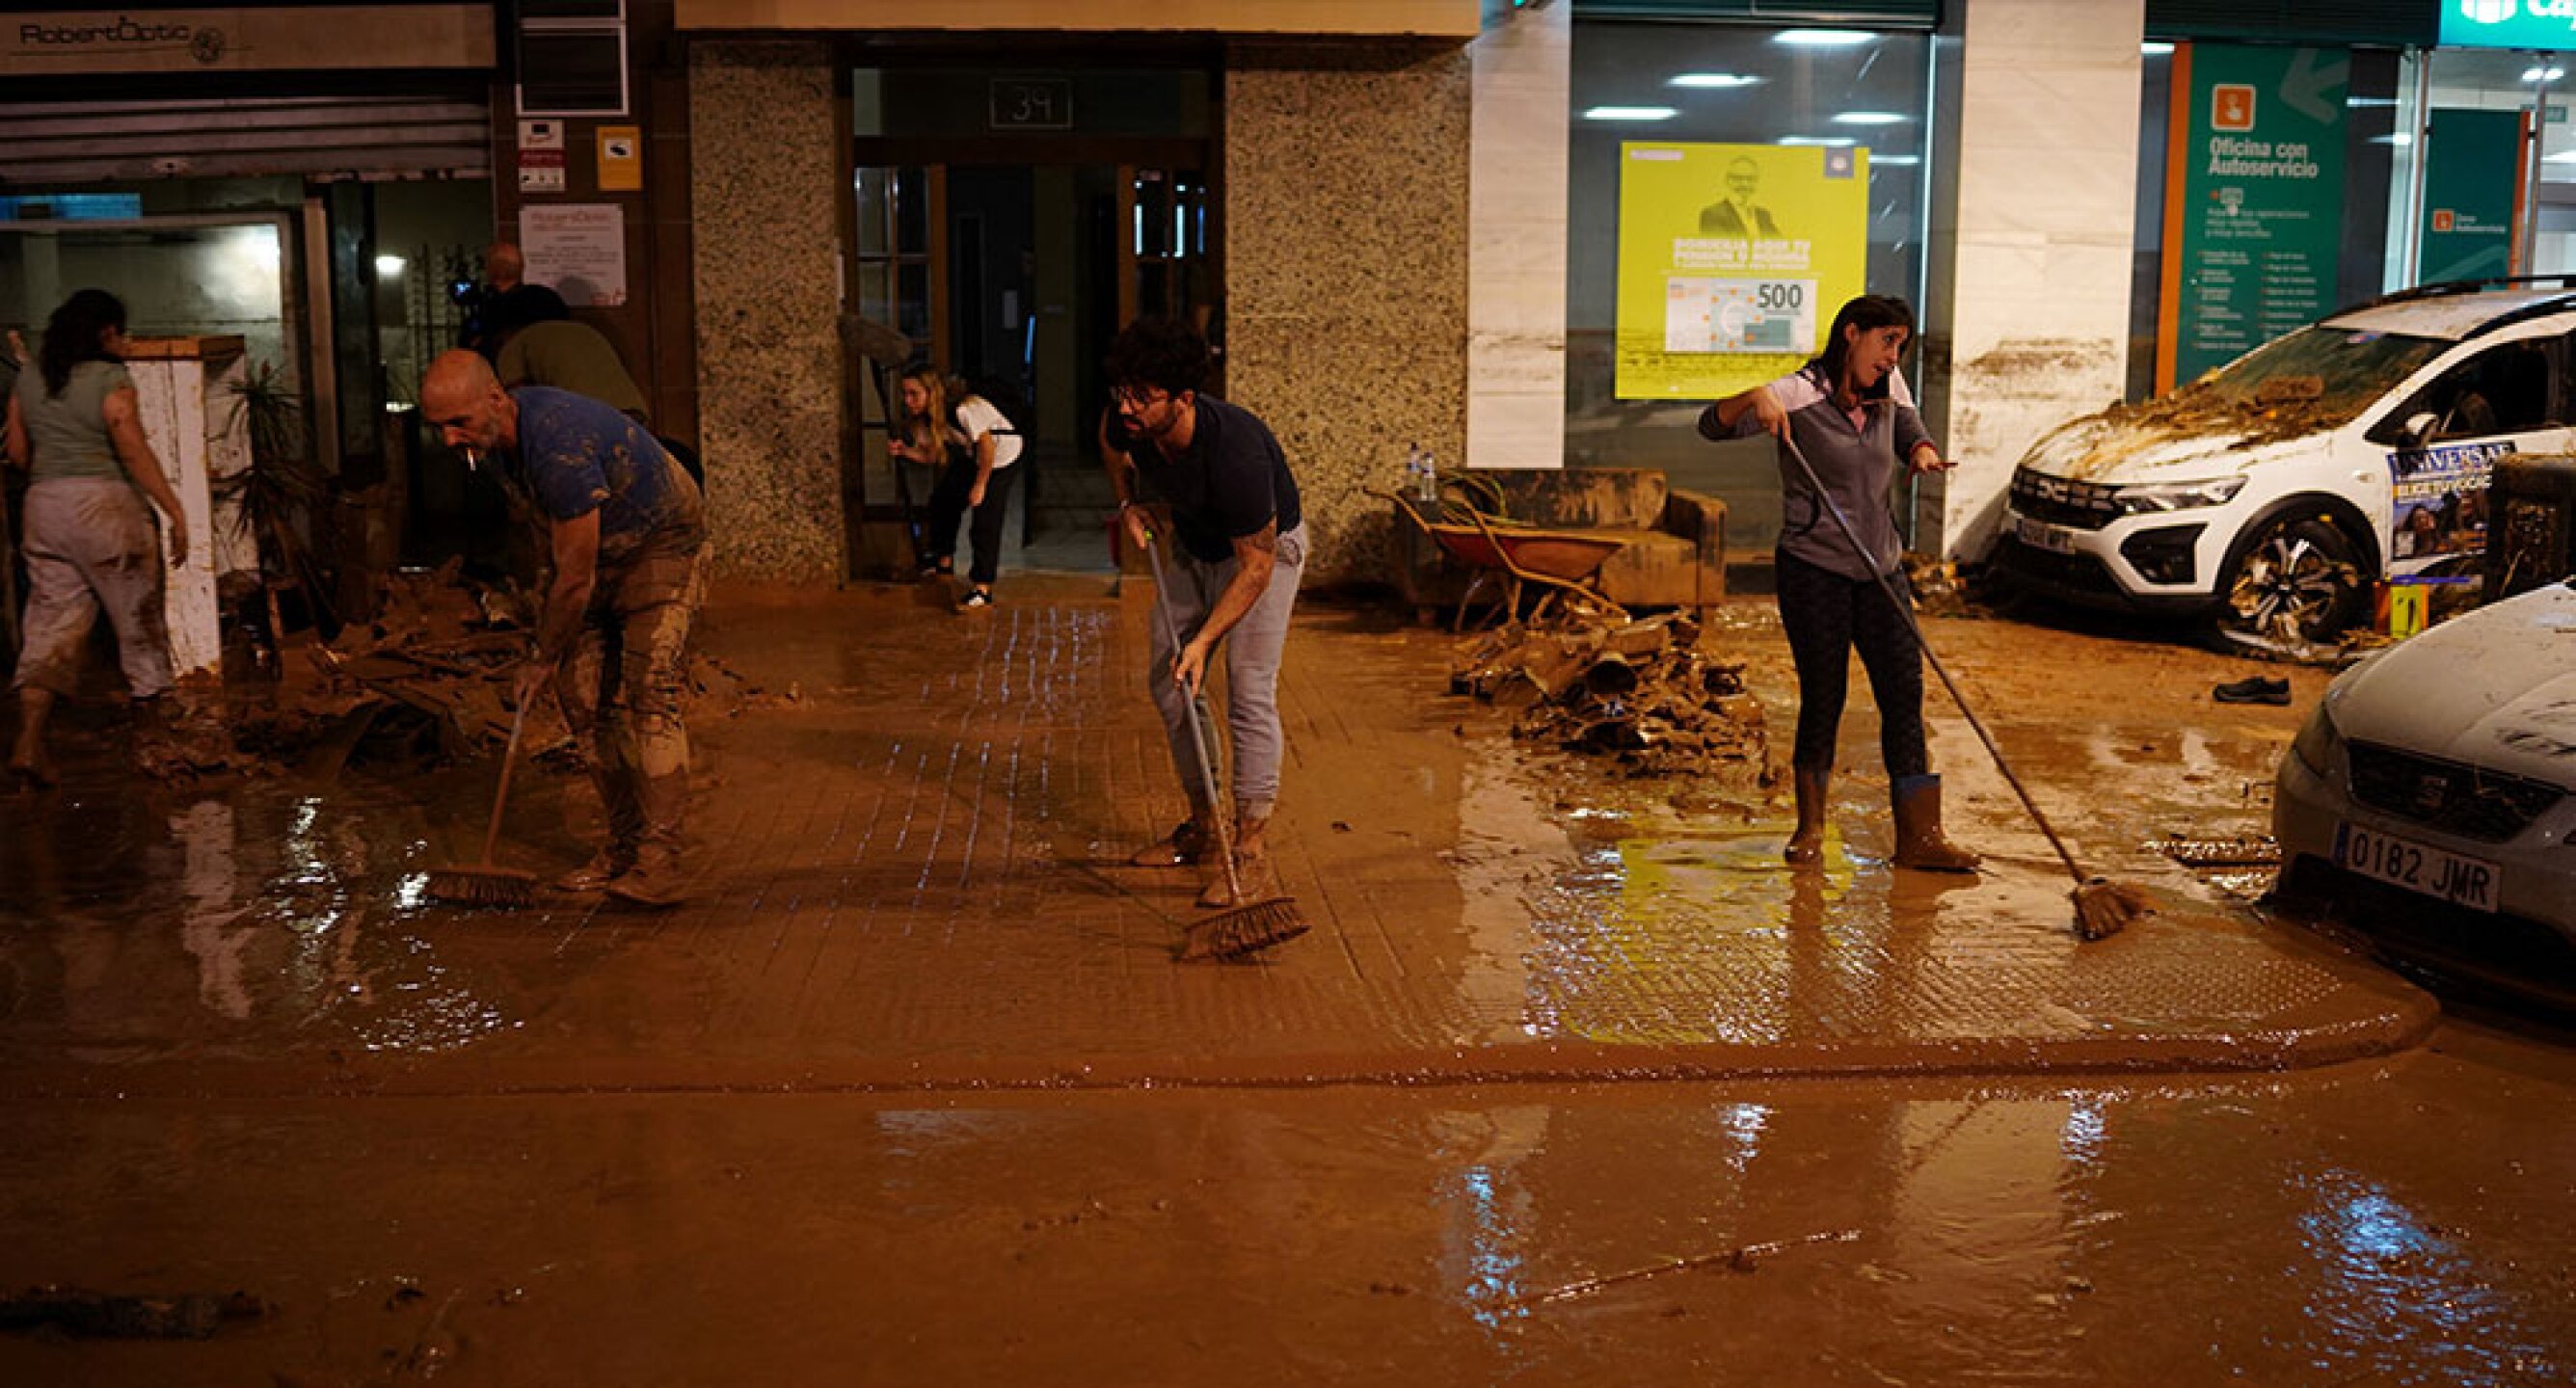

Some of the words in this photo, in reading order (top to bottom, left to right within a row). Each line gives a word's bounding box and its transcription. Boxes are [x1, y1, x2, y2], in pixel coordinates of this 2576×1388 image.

[2527, 0, 2576, 31] Ca
[1011, 85, 1052, 120] 39
[2210, 136, 2271, 157] Oficina
[2276, 143, 2308, 158] con
[2208, 156, 2319, 178] Autoservicio
[1757, 284, 1804, 308] 500
[2353, 833, 2423, 885] 0182
[2432, 858, 2491, 906] JMR
